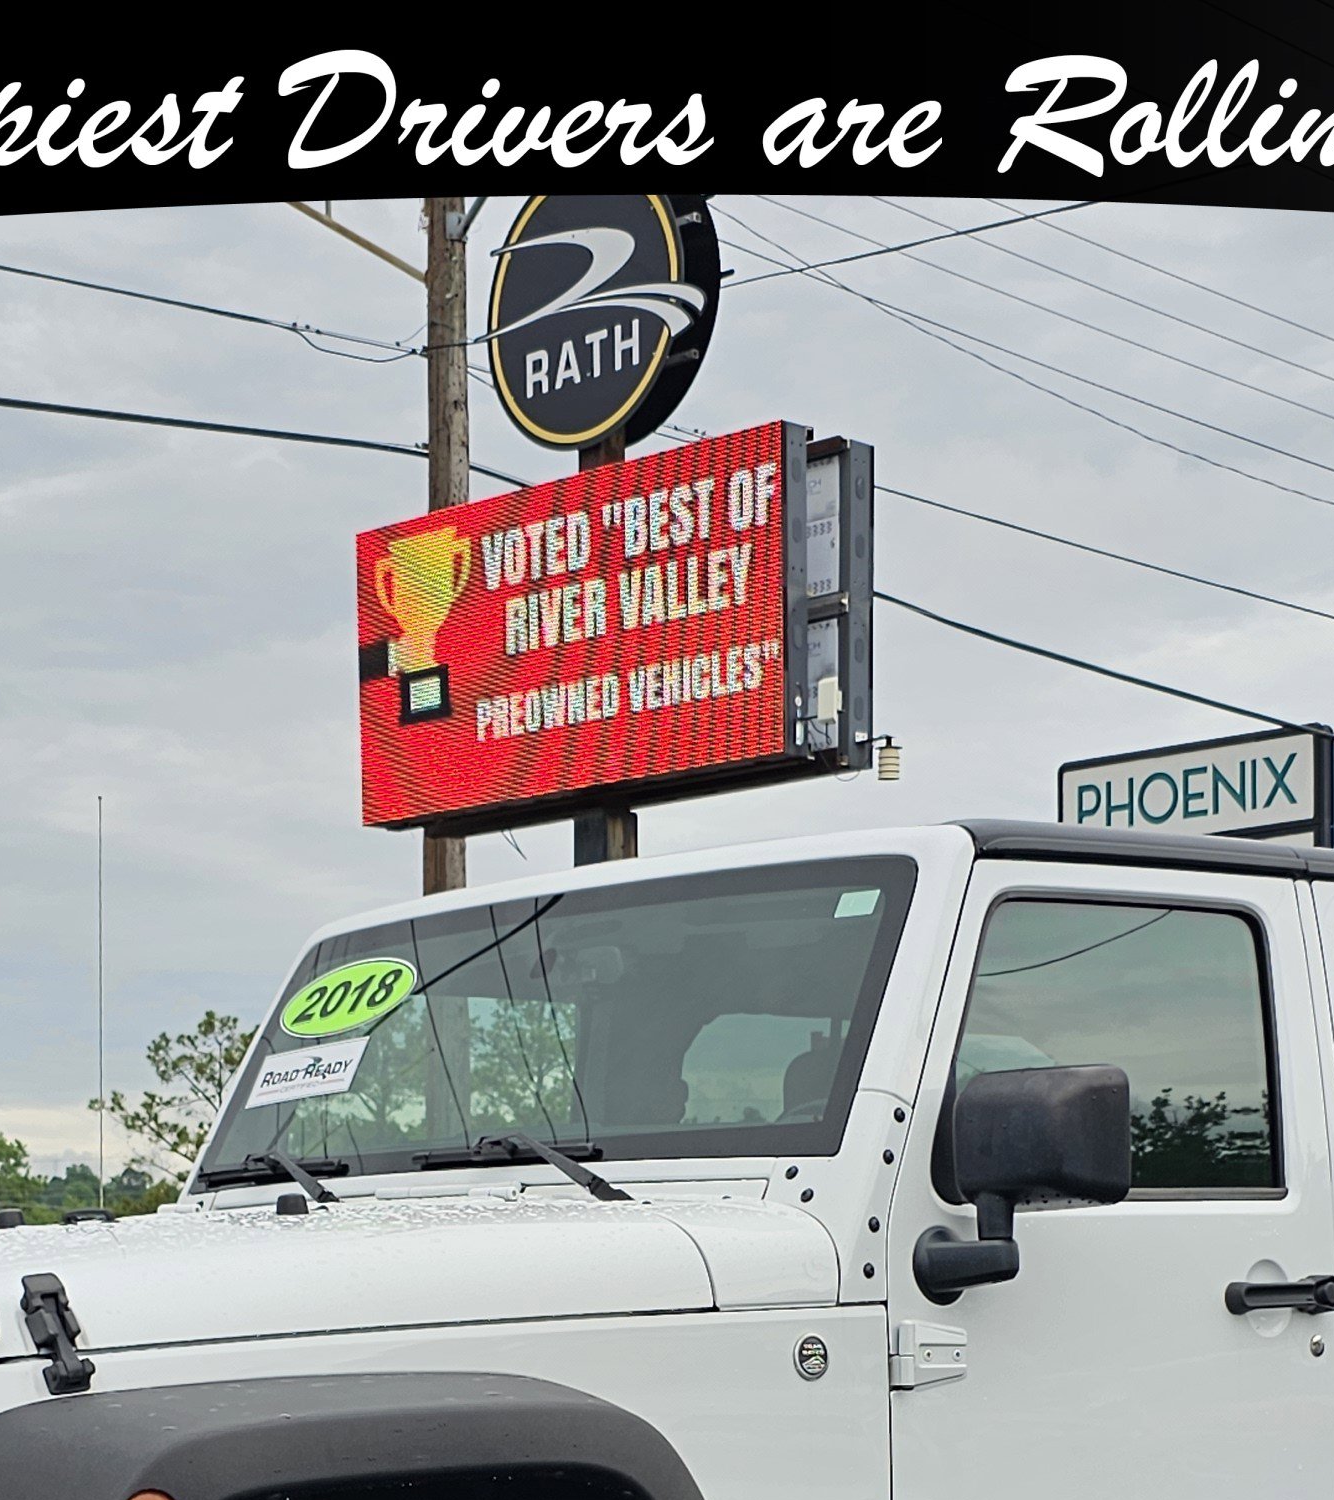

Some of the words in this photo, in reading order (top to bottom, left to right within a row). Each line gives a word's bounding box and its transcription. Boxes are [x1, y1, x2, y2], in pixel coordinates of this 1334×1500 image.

[525, 318, 642, 399] RATH
[480, 509, 590, 591] VOTED
[728, 462, 777, 533] OF
[504, 580, 607, 656] RIVER
[619, 544, 754, 631] VALLEY
[474, 673, 620, 742] PREOWNED
[1077, 752, 1298, 828] PHOENIX
[290, 968, 403, 1027] 2018
